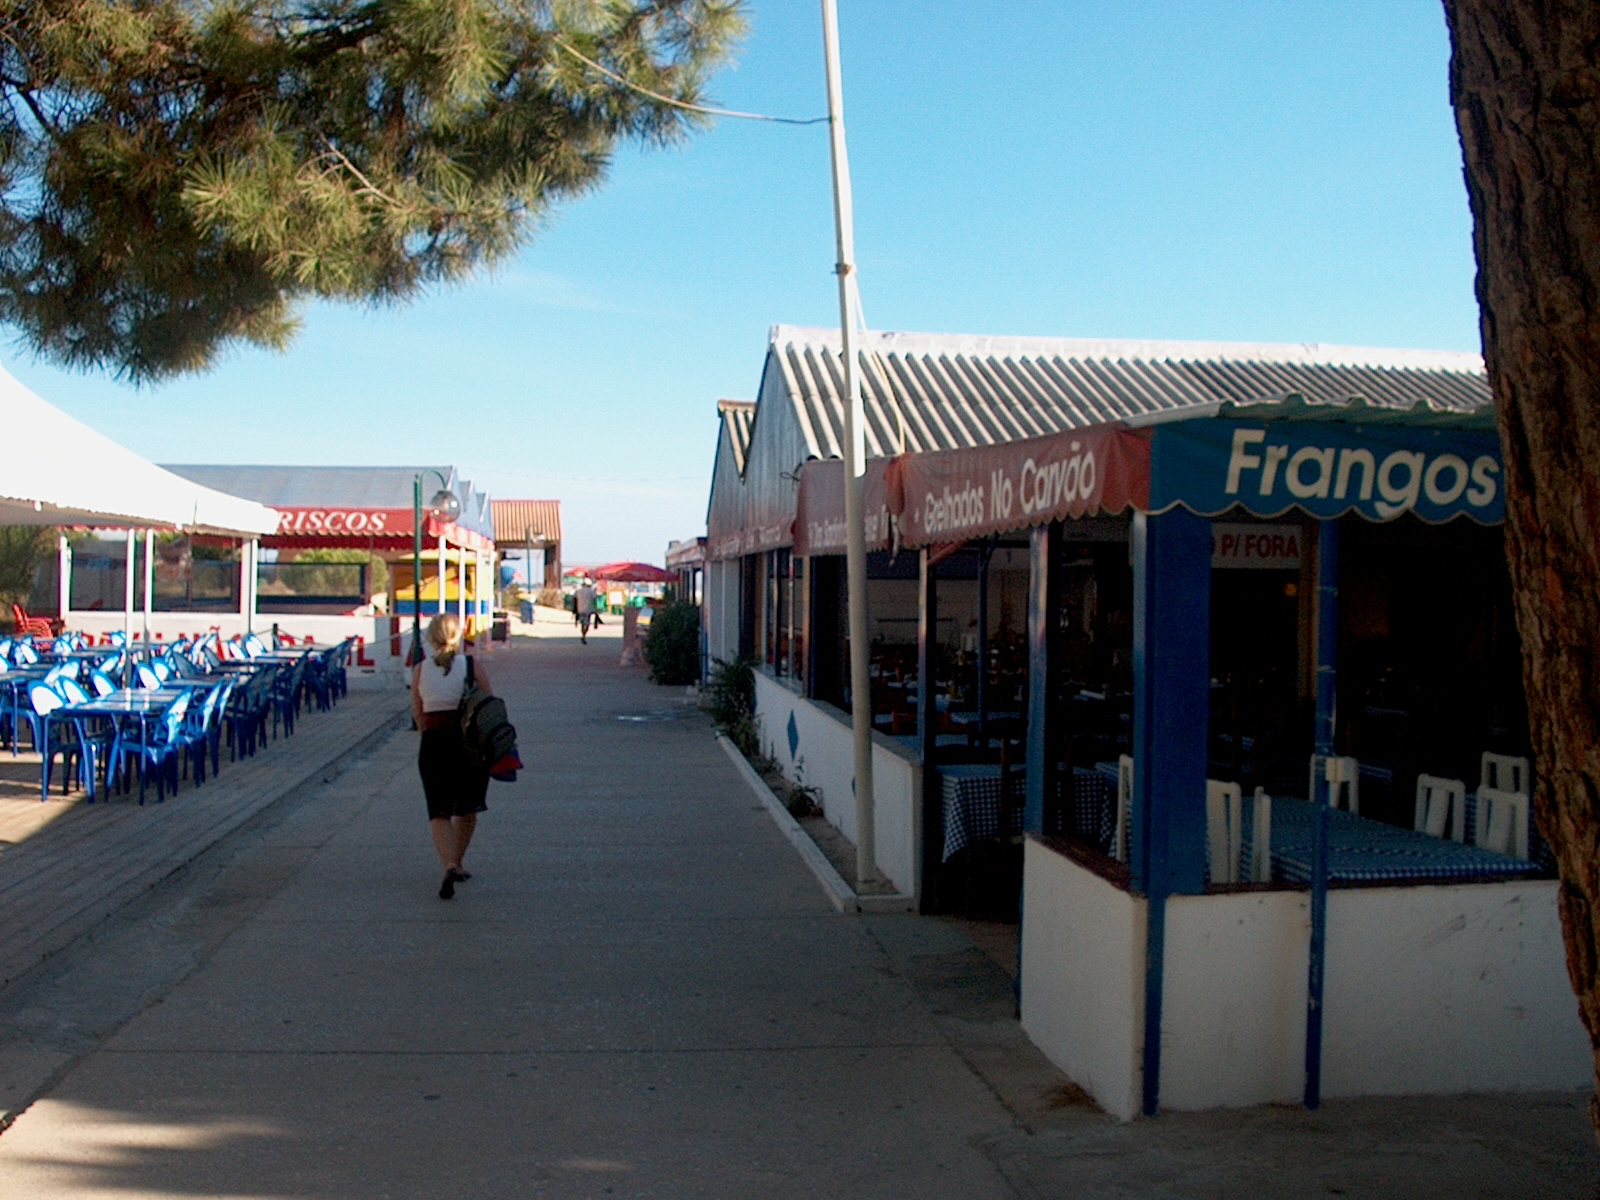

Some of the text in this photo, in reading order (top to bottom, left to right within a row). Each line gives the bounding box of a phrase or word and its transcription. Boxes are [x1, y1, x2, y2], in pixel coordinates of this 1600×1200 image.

[924, 479, 985, 534] Grelhados
[990, 468, 1013, 521] No
[1020, 441, 1096, 515] Carvão
[1225, 428, 1499, 518] Frangos
[1244, 534, 1298, 558] FORA
